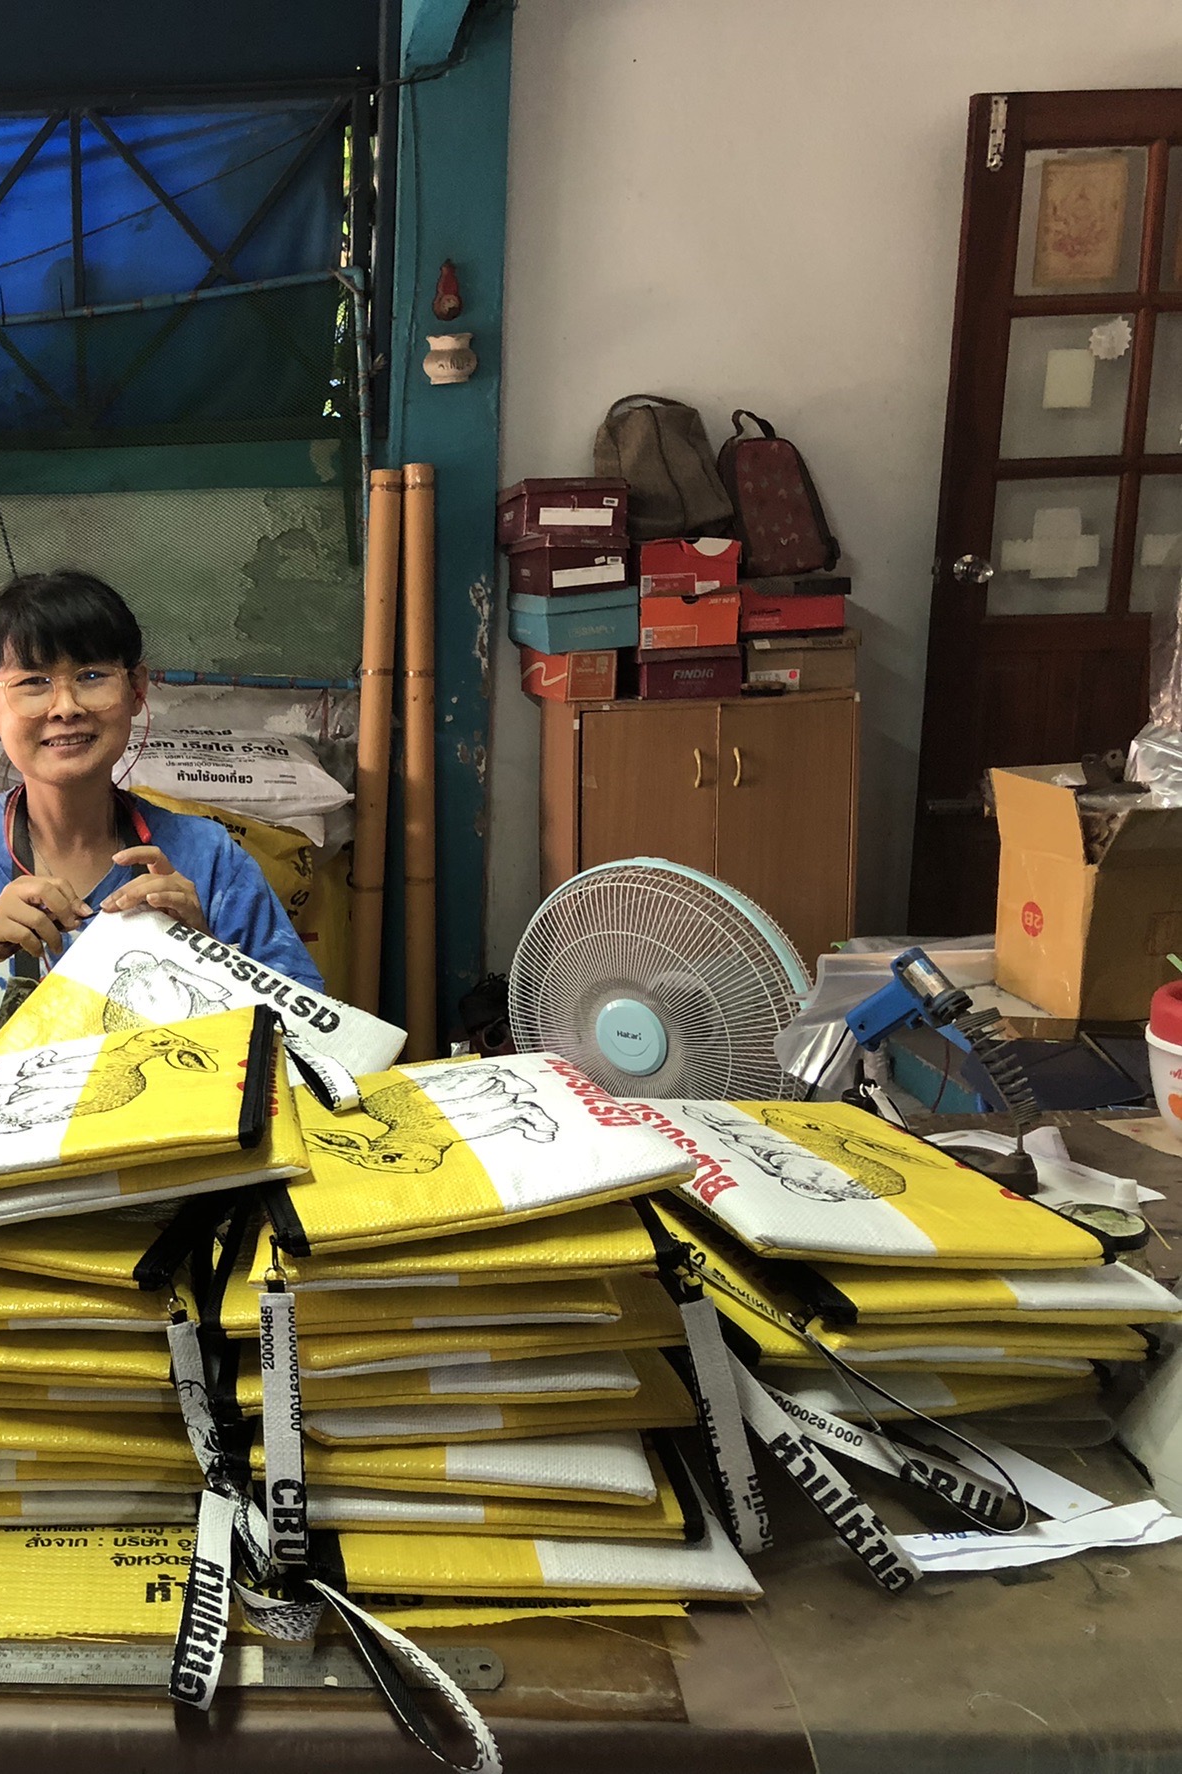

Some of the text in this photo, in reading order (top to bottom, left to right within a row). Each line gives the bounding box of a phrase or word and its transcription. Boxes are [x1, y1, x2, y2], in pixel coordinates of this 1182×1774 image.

[673, 668, 715, 680] FINDIG
[176, 769, 254, 785] ห้ามใช้ขอเกี่ยว
[616, 1030, 642, 1041] Hatari
[259, 1305, 276, 1371] 2000485
[24, 1533, 89, 1549] สั่งจาก
[112, 1535, 169, 1548] บริษัท
